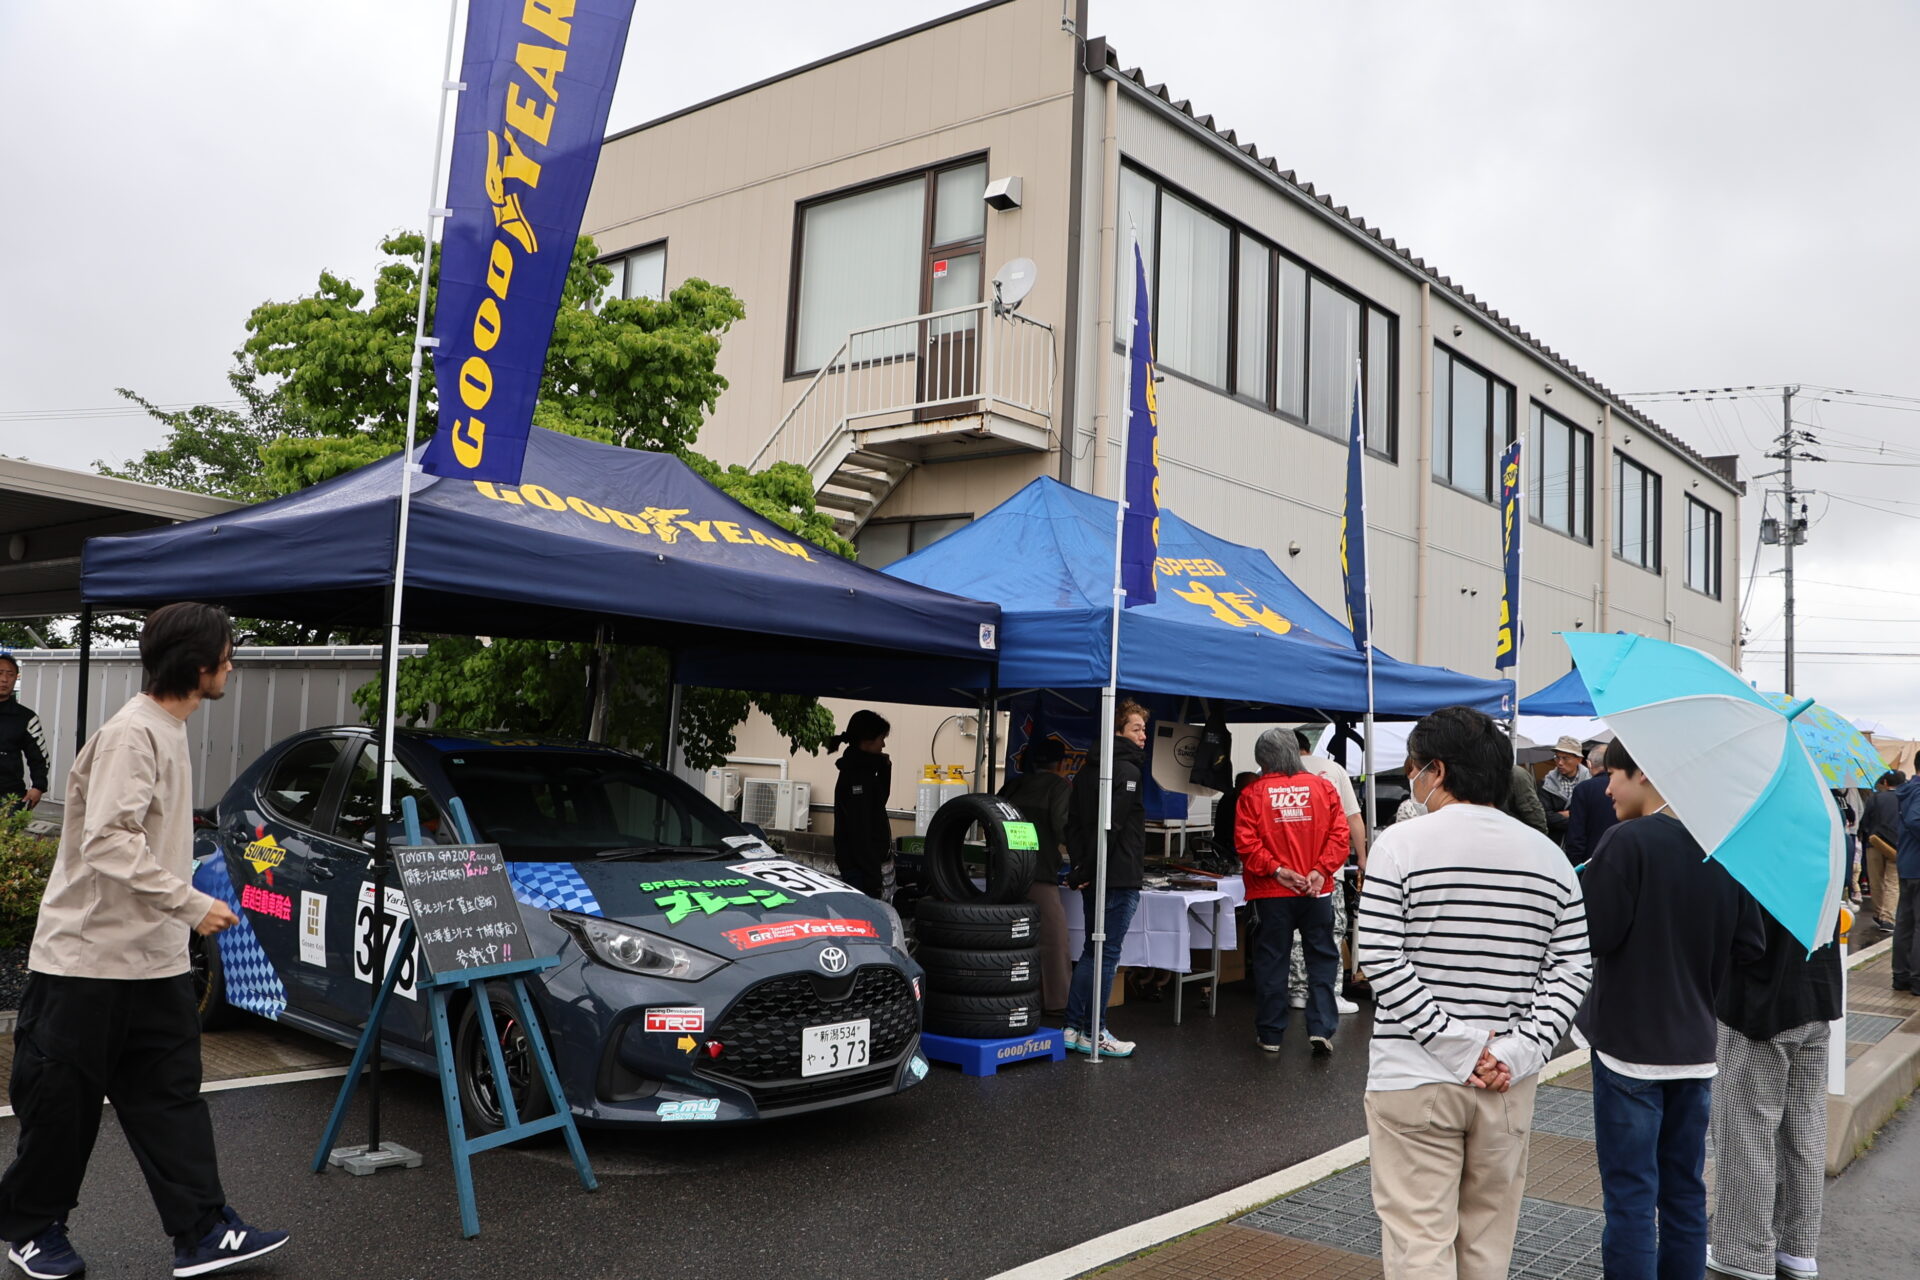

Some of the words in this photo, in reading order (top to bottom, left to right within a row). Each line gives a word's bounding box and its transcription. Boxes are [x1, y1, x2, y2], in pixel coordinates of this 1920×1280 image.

[473, 480, 819, 563] GOODYEAR
[1156, 557, 1227, 576] SPEED
[1268, 786, 1291, 794] Racing
[1290, 785, 1310, 793] Team
[245, 843, 285, 865] SUNOCO
[399, 851, 435, 867] TOYOTA
[438, 849, 469, 863] GAZOO
[640, 879, 701, 892] SPEED
[702, 878, 749, 888] SHOP
[241, 884, 293, 921] 信越自動車商会
[654, 889, 798, 925] プレーン
[794, 922, 846, 934] Yaris
[648, 1016, 700, 1031] TRD
[997, 1039, 1052, 1059] GOODYEAR
[219, 1230, 248, 1251] N
[19, 1240, 41, 1263] N
